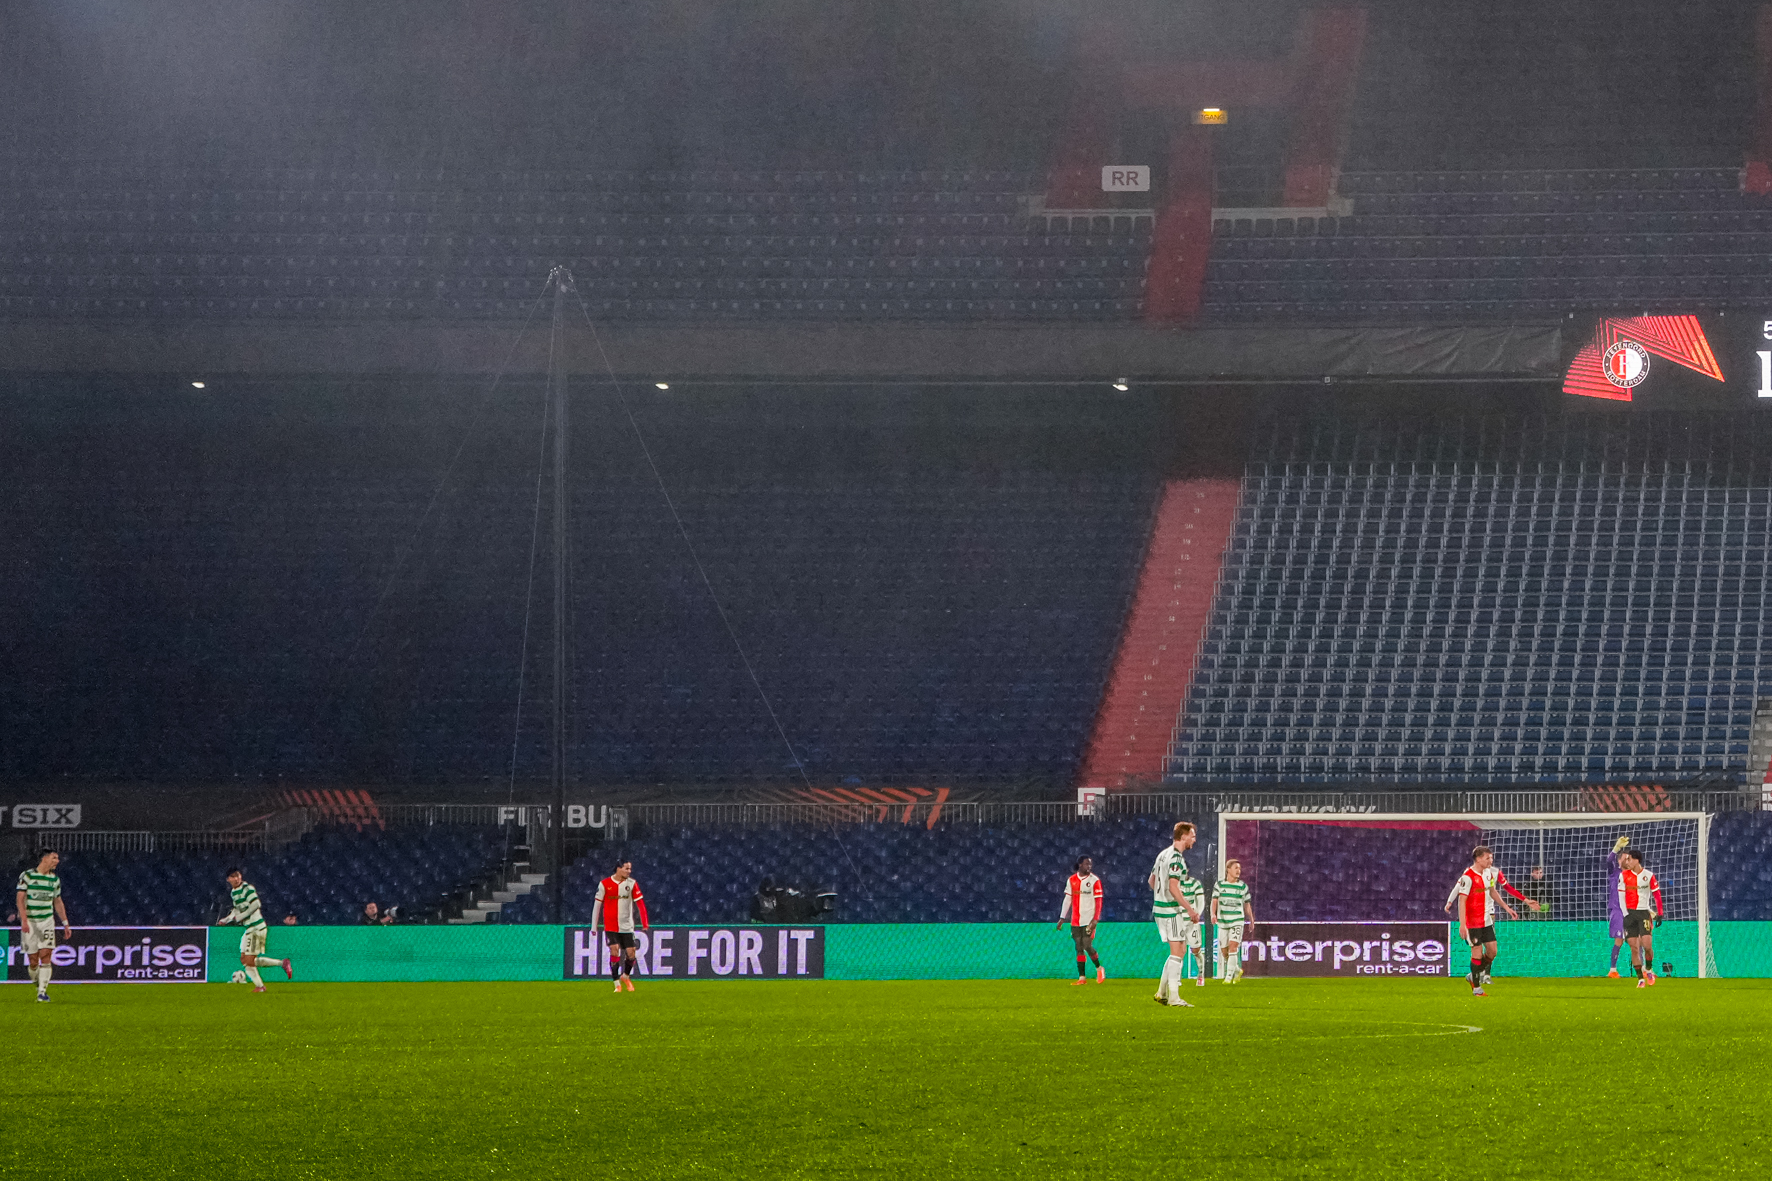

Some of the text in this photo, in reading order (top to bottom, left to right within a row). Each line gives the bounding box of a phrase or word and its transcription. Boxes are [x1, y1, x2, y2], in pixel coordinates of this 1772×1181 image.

[1111, 171, 1139, 186] RR
[1607, 370, 1646, 387] ROTTERDAM
[18, 807, 75, 825] SIX
[0, 937, 203, 974] nerprise
[687, 930, 763, 975] FOR
[1241, 933, 1445, 970] nterprise
[117, 966, 201, 978] rent-a-car
[1356, 963, 1444, 974] rent-a-car
